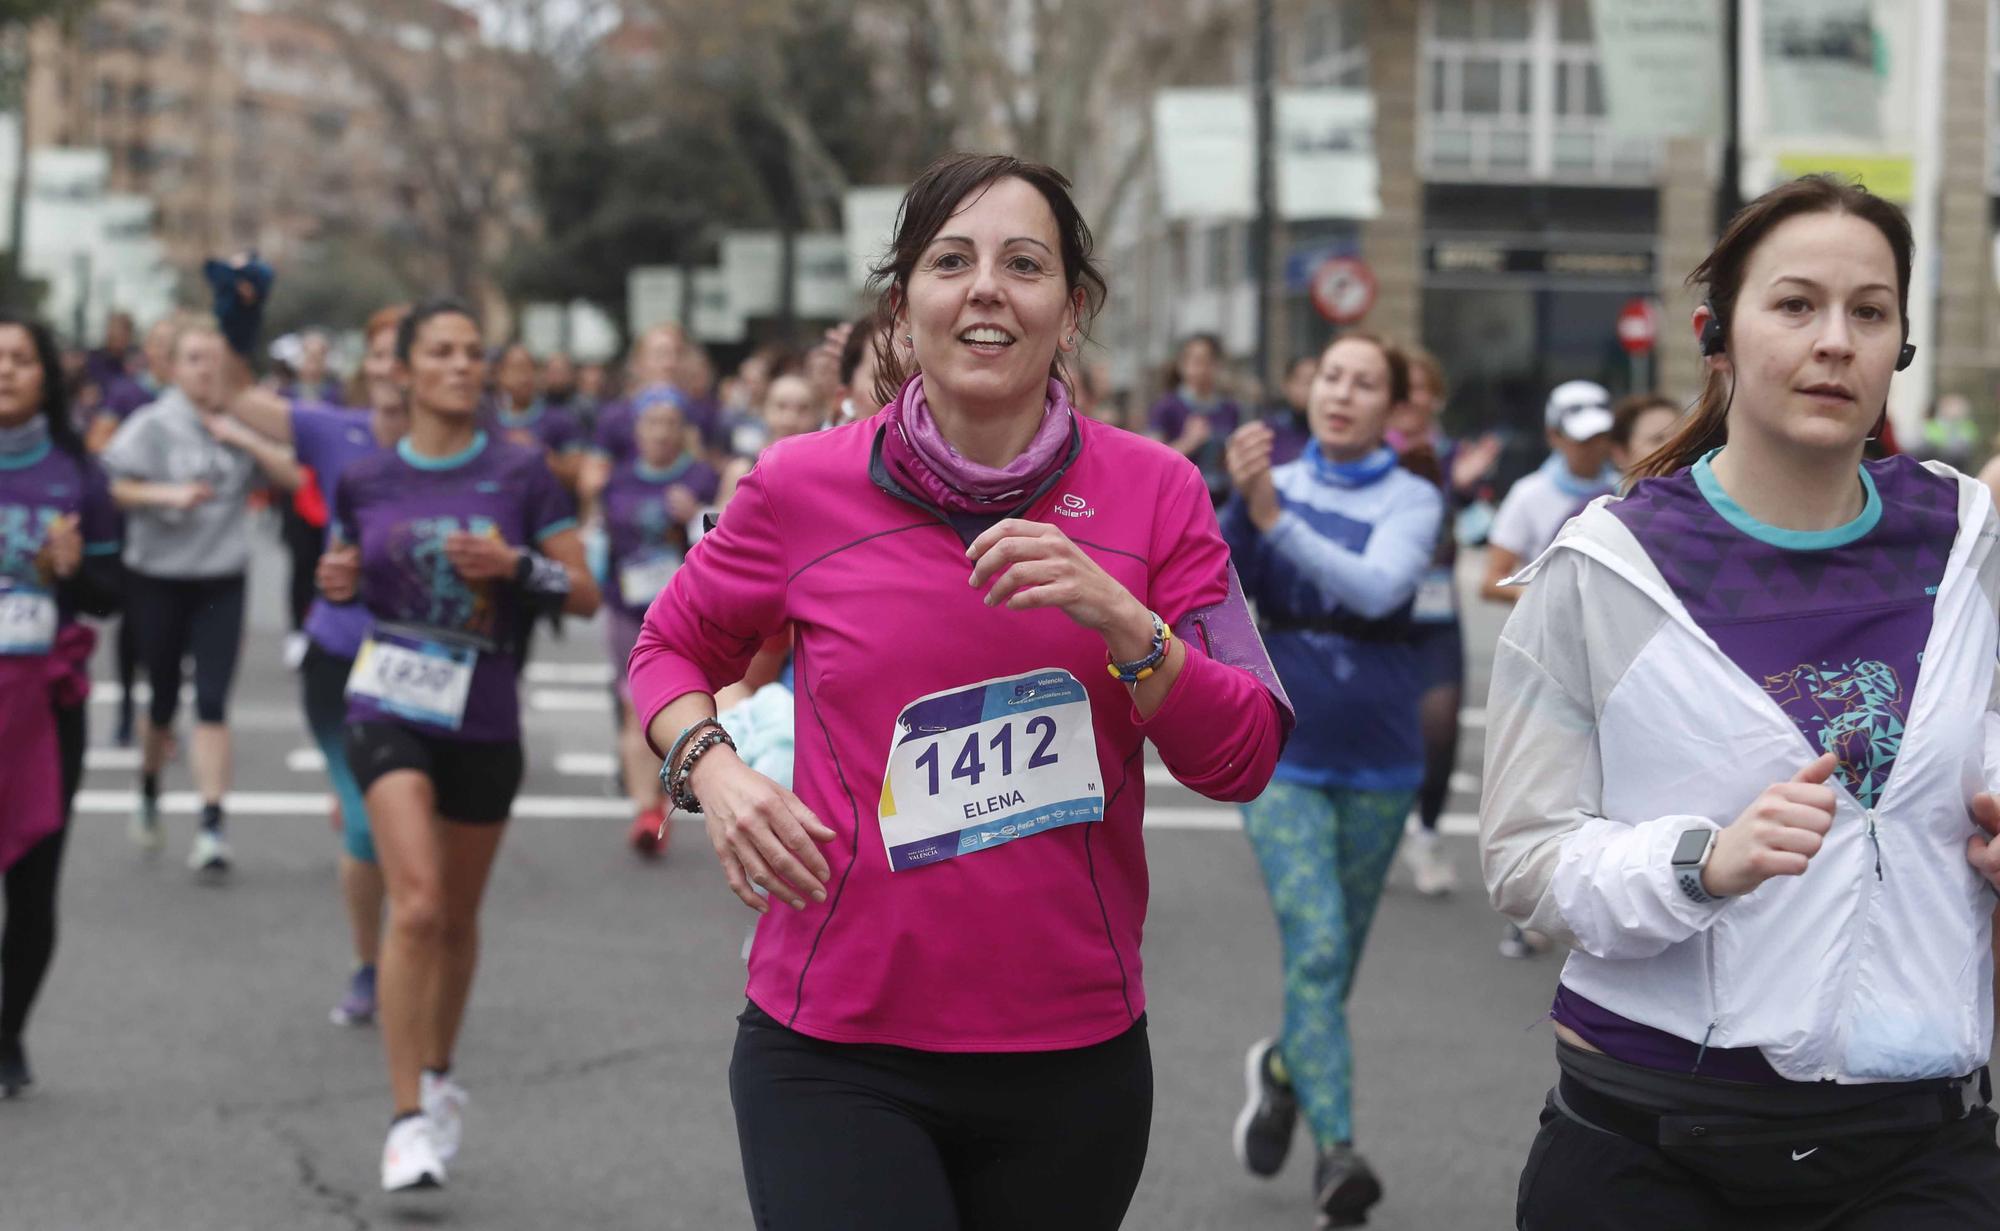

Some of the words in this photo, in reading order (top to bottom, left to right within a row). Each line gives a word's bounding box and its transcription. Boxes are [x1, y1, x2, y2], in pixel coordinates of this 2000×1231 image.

[1054, 504, 1095, 518] Kalenji
[1037, 676, 1064, 687] Valencia
[915, 715, 1058, 796] 1412
[1087, 782, 1095, 791] M
[963, 790, 1025, 819] ELENA
